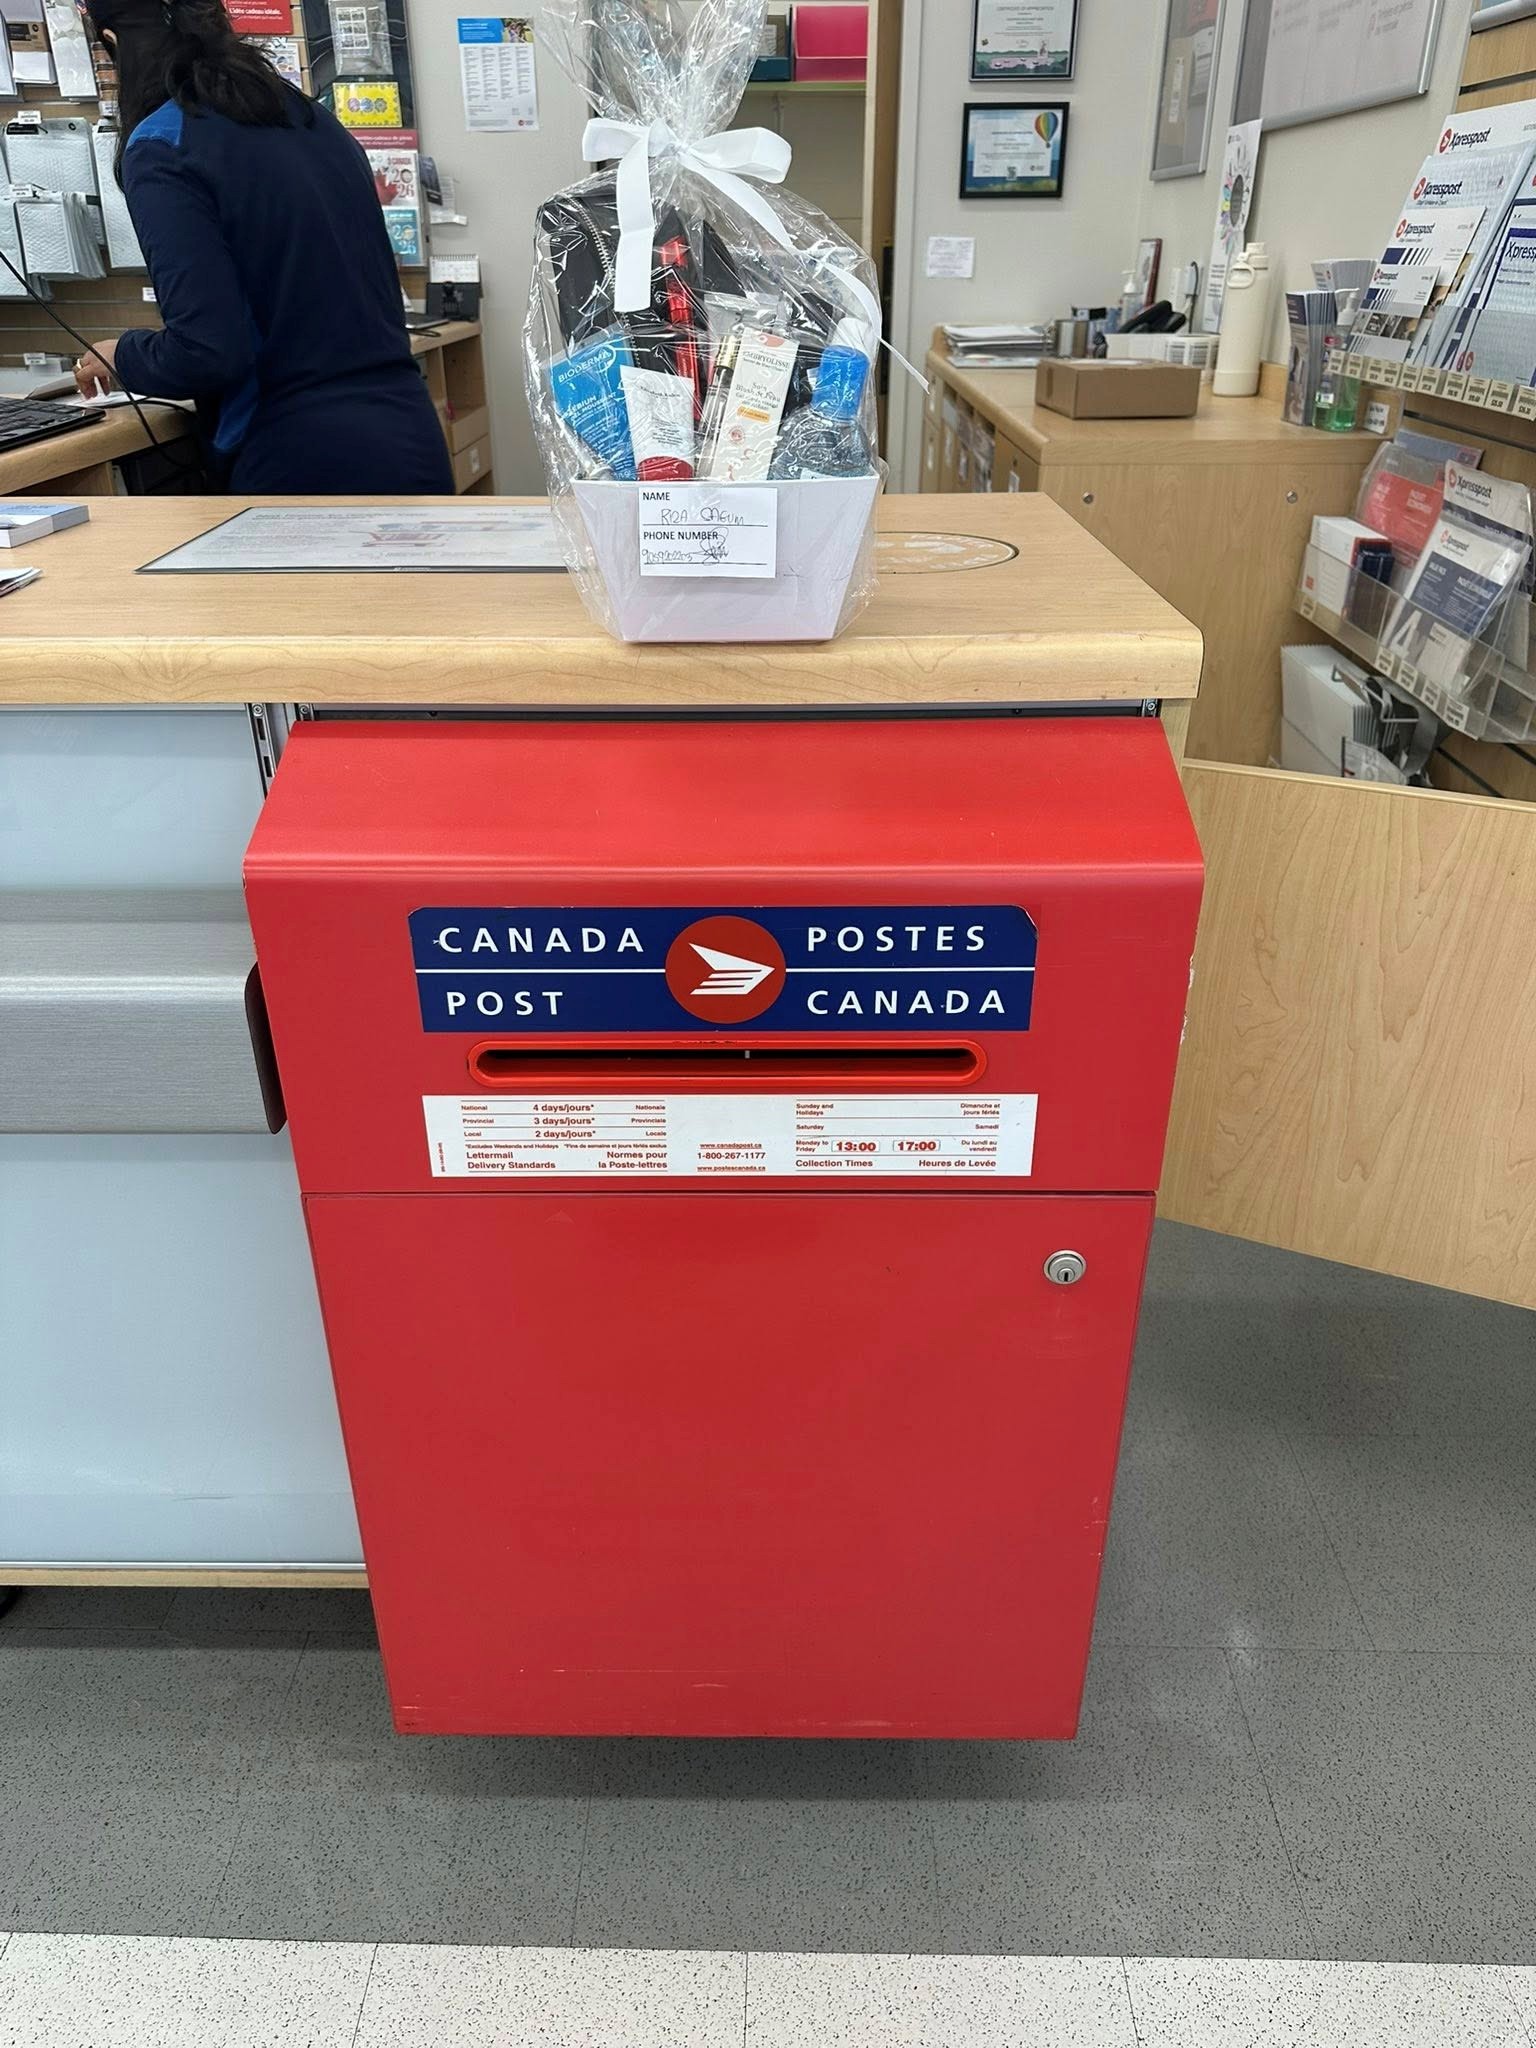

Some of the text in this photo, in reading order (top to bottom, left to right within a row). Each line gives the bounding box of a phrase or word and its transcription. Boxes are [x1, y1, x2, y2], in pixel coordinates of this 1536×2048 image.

[1449, 127, 1492, 150] Xpresspost
[1421, 181, 1462, 198] Xpresspost
[558, 348, 612, 383] BIODERMA
[643, 492, 671, 501] NAME
[643, 531, 719, 540] PHONE NUMBER
[438, 927, 644, 953] CANADA
[807, 925, 986, 952] POSTES
[446, 991, 563, 1016] POST
[807, 990, 1005, 1015] CANADA
[534, 1117, 540, 1125] 3
[535, 1130, 541, 1138] 2
[836, 1142, 876, 1151] 13:00
[897, 1141, 937, 1151] 17:00
[607, 1151, 668, 1160] Normes pour
[697, 1152, 766, 1160] 1-800-267-1177
[467, 1162, 506, 1170] Delivery
[598, 1161, 668, 1169] la Poste-lettres
[795, 1159, 873, 1167] Collection Times
[918, 1158, 997, 1167] Heures de Levée
